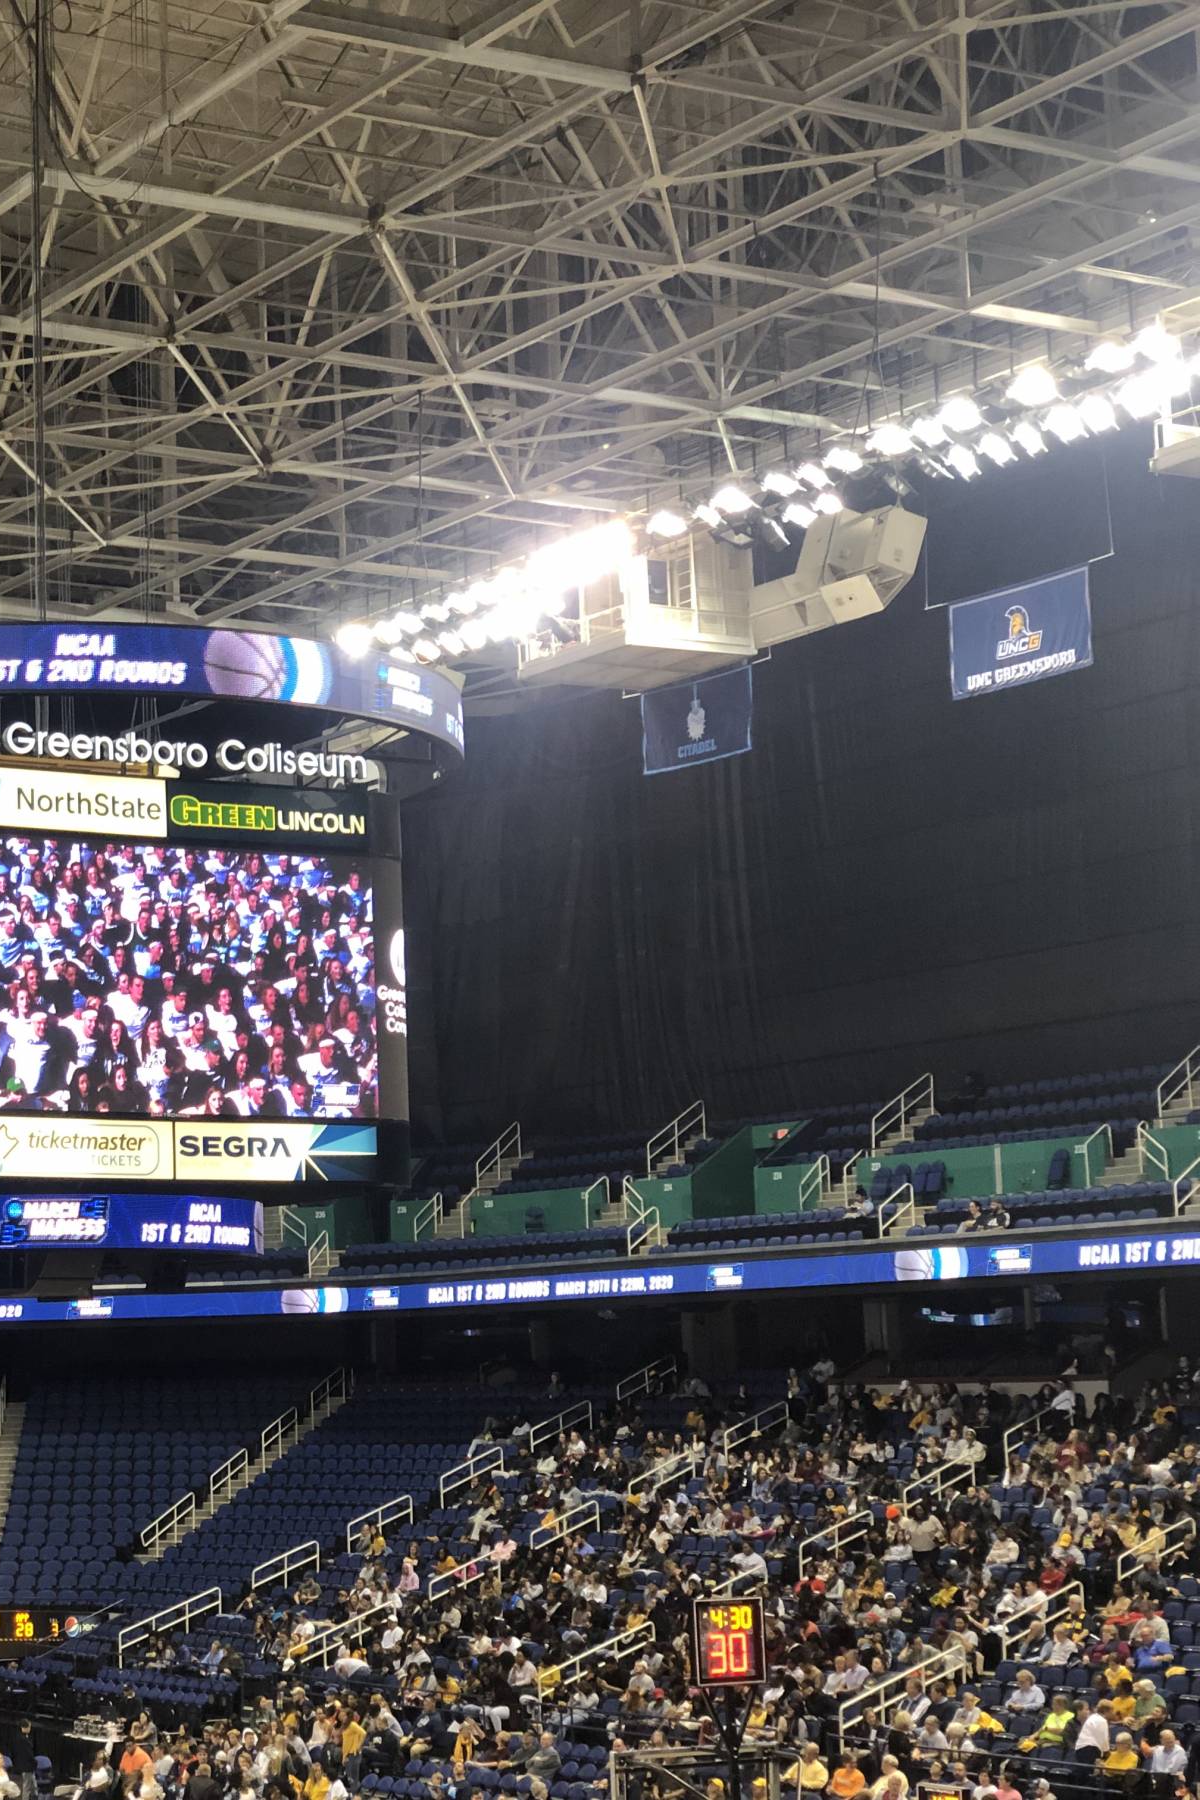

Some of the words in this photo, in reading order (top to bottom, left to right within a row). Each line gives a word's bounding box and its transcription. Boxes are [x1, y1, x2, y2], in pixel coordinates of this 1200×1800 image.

[55, 634, 116, 656] NCAA
[998, 633, 1041, 659] UNCG
[48, 660, 94, 682] 2ND
[99, 660, 187, 684] ROUNDS
[967, 671, 993, 690] UNC
[3, 722, 208, 768] Greensboro
[218, 738, 367, 779] Coliseum
[17, 787, 161, 820] NorthState
[170, 795, 276, 832] GREEN
[277, 810, 366, 835] LINCOLN
[28, 1130, 147, 1152] ticketmaster
[179, 1135, 293, 1158] SEGRA
[23, 1202, 80, 1219] MARCH
[189, 1203, 222, 1223] NCAA
[30, 1218, 106, 1237] MADNESS
[141, 1223, 167, 1242] 1ST
[183, 1225, 211, 1244] 2ND
[213, 1226, 250, 1246] ROUNDS
[1079, 1244, 1120, 1266] NCAA
[1125, 1242, 1152, 1263] 1ST
[428, 1286, 454, 1304] NCAA
[457, 1285, 474, 1302] 1ST
[485, 1283, 506, 1300] 2ND
[509, 1280, 550, 1299] ROUNDS
[649, 1275, 674, 1290] 2020
[16, 1622, 34, 1637] 28
[709, 1606, 753, 1630] 4:30
[51, 1623, 59, 1637] 3
[709, 1632, 749, 1675] 30
